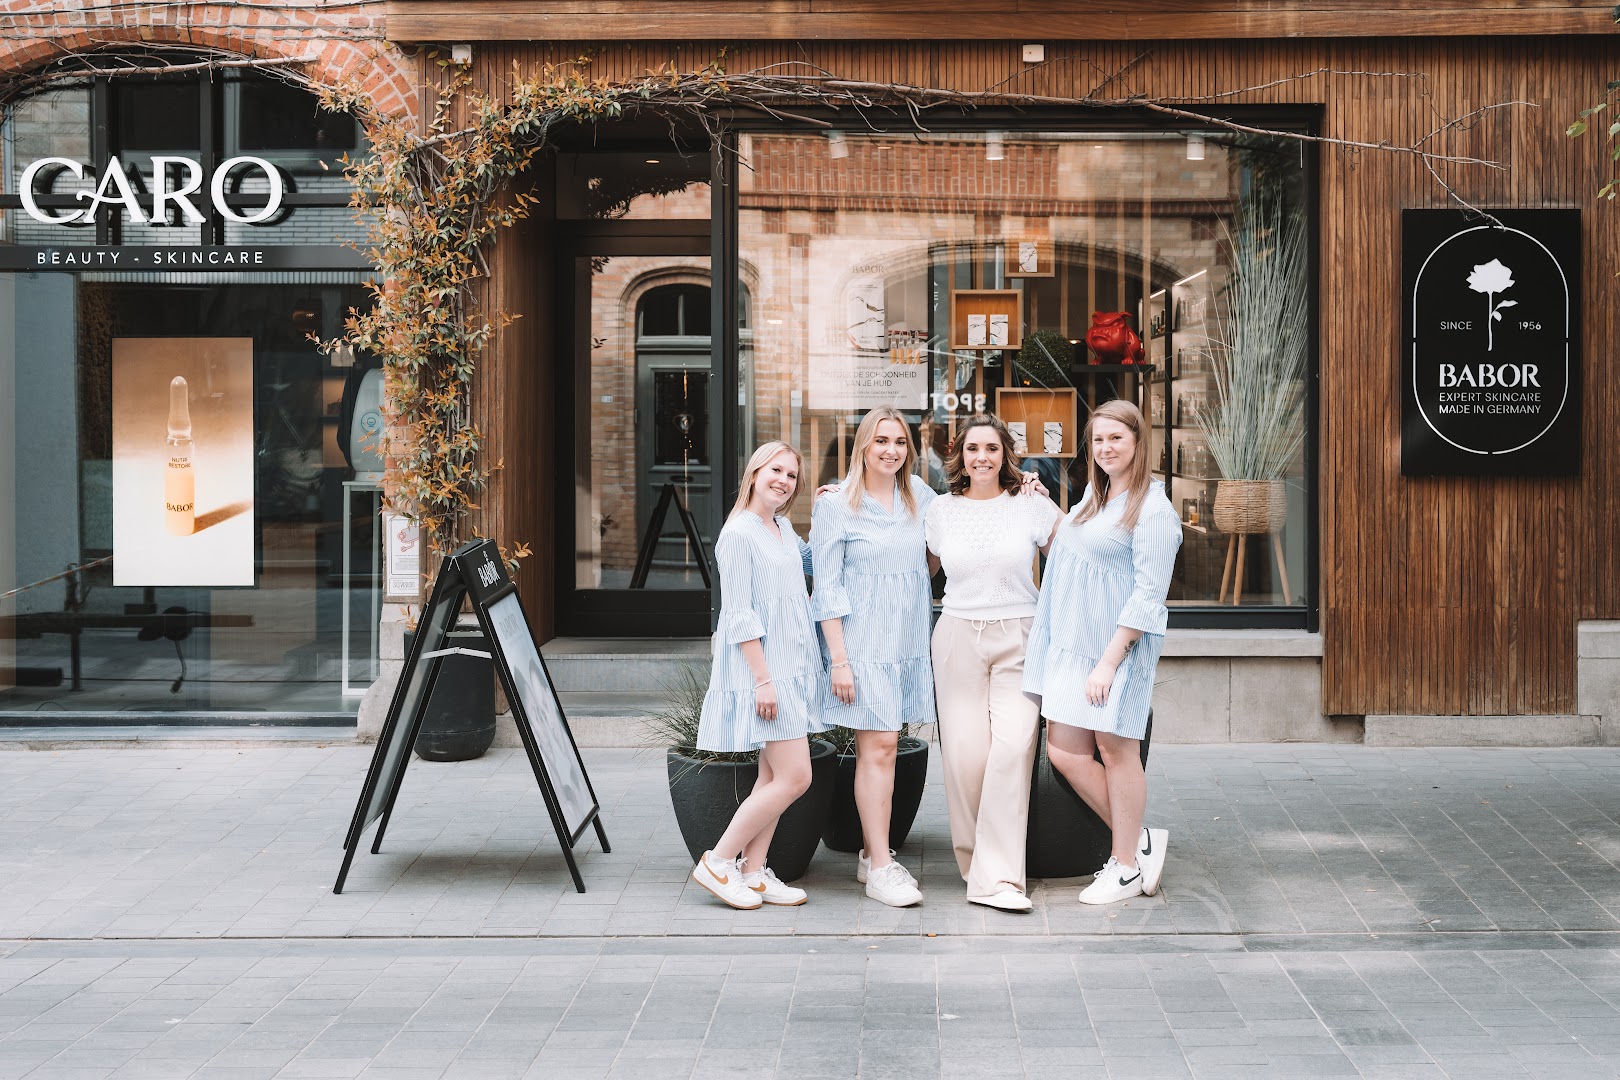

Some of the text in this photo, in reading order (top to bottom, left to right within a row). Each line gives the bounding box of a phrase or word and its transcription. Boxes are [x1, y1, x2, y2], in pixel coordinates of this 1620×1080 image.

[19, 155, 283, 224] CARO
[37, 251, 120, 265] BEAUTY
[153, 251, 264, 265] SKINCARE
[852, 265, 885, 274] BABOR
[1440, 321, 1542, 331] SINCE 1956
[853, 371, 863, 379] DE
[865, 371, 917, 379] SCHOONHEID
[1439, 363, 1542, 388] BABOR
[845, 379, 893, 387] VAN JE HUID
[1439, 392, 1541, 403] EXPERT SKINCARE
[1438, 404, 1541, 415] MADE IN GERMANY
[166, 502, 194, 512] BABOR
